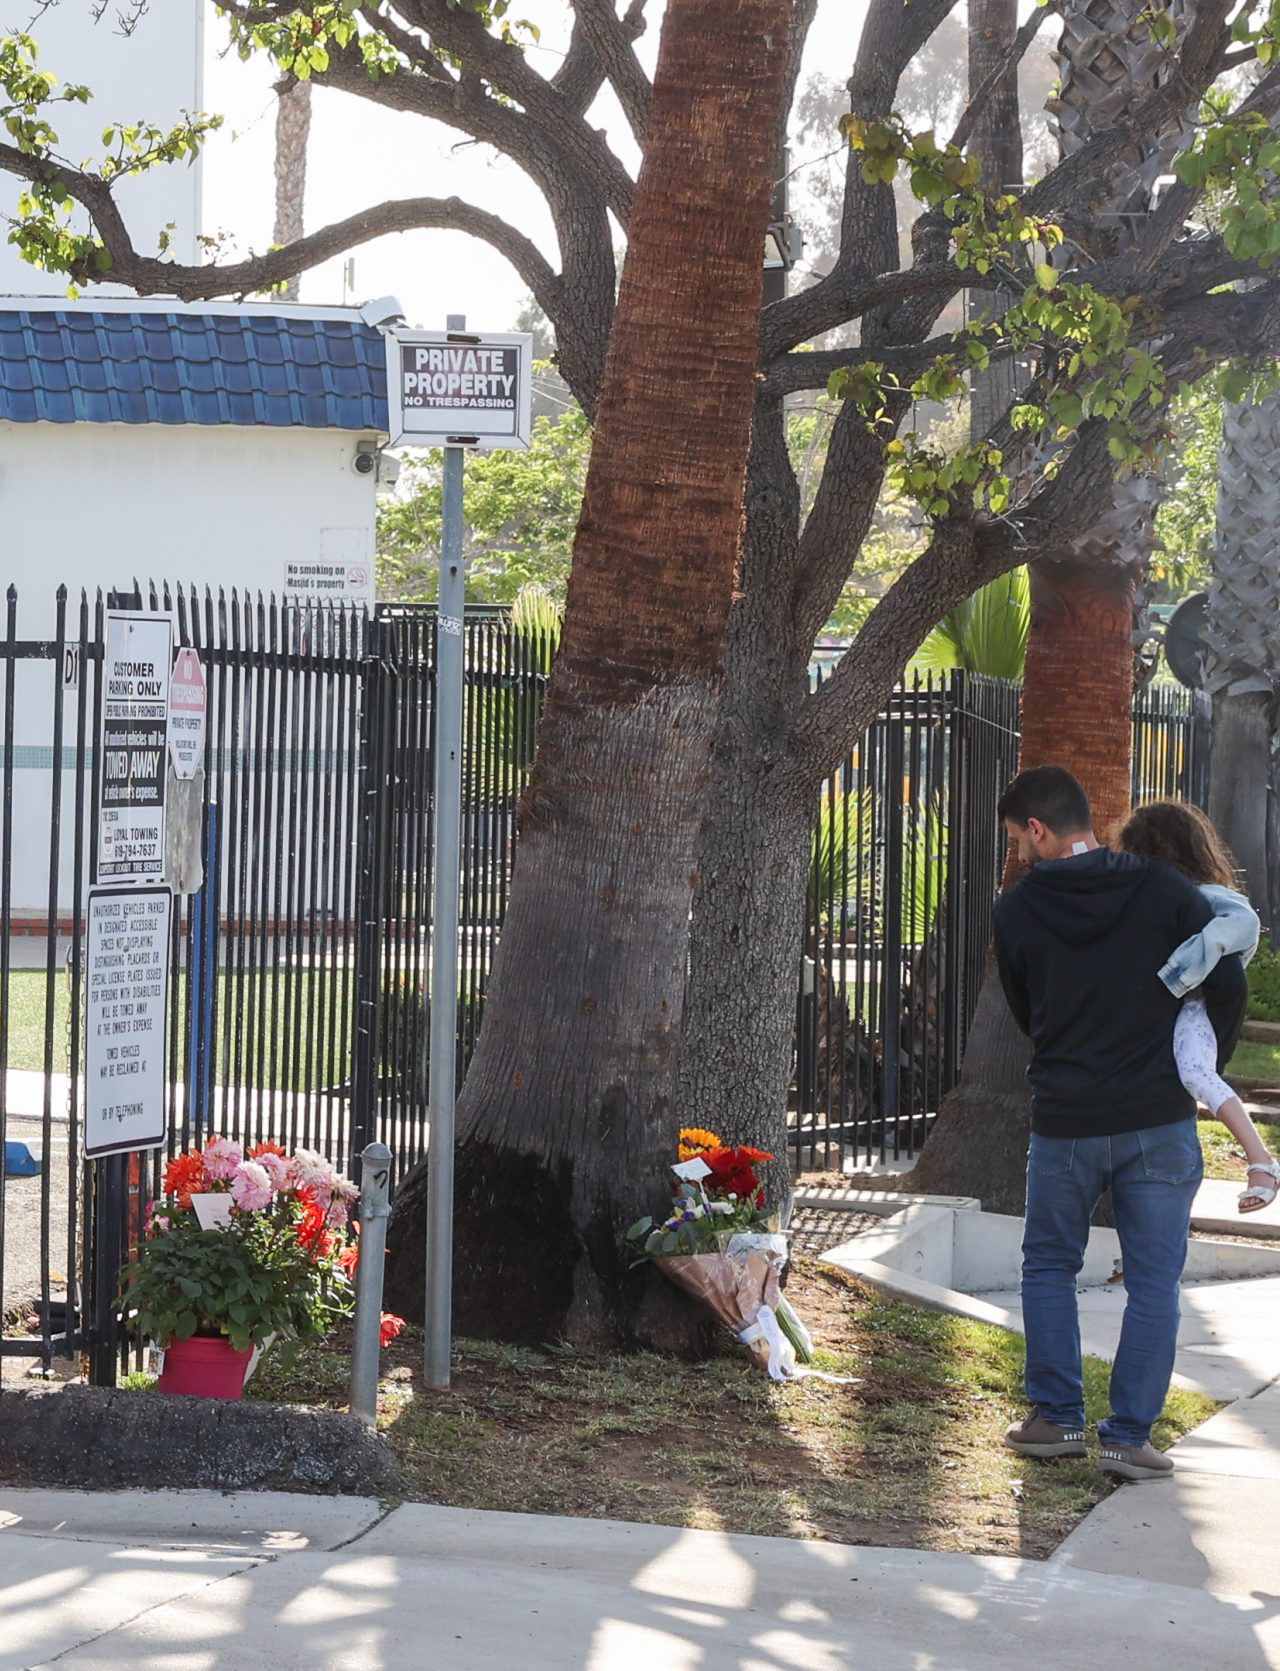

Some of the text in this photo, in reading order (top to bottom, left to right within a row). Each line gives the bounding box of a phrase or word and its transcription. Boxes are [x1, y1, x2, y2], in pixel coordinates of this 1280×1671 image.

[415, 348, 504, 372] PRIVATE
[404, 372, 515, 396] PROPERTY
[404, 396, 514, 408] NO TRESPASSING
[288, 564, 345, 577] No smoking on
[287, 578, 345, 590] Masjids property
[113, 661, 155, 678] CUSTOMER
[108, 680, 162, 696] PARKING ONLY
[106, 751, 160, 779] TOWED AWAY
[131, 827, 158, 841] TOWING
[123, 903, 145, 915] VEHICLES
[148, 902, 165, 914] PARKED
[130, 919, 157, 932] ACCESSIBLE
[127, 952, 150, 966] PLACARDS
[152, 951, 159, 964] OR
[108, 971, 125, 985] LICENSE
[127, 969, 143, 982] PLATES
[146, 968, 162, 981] ISSUED
[100, 988, 118, 1002] PERSONS
[133, 984, 161, 999] DISABILITIES
[112, 1005, 118, 1018] BE
[103, 1022, 111, 1035] THE
[133, 1018, 153, 1032] EXPENSE
[121, 1045, 140, 1058] VEHICLES
[109, 1064, 115, 1077] BE
